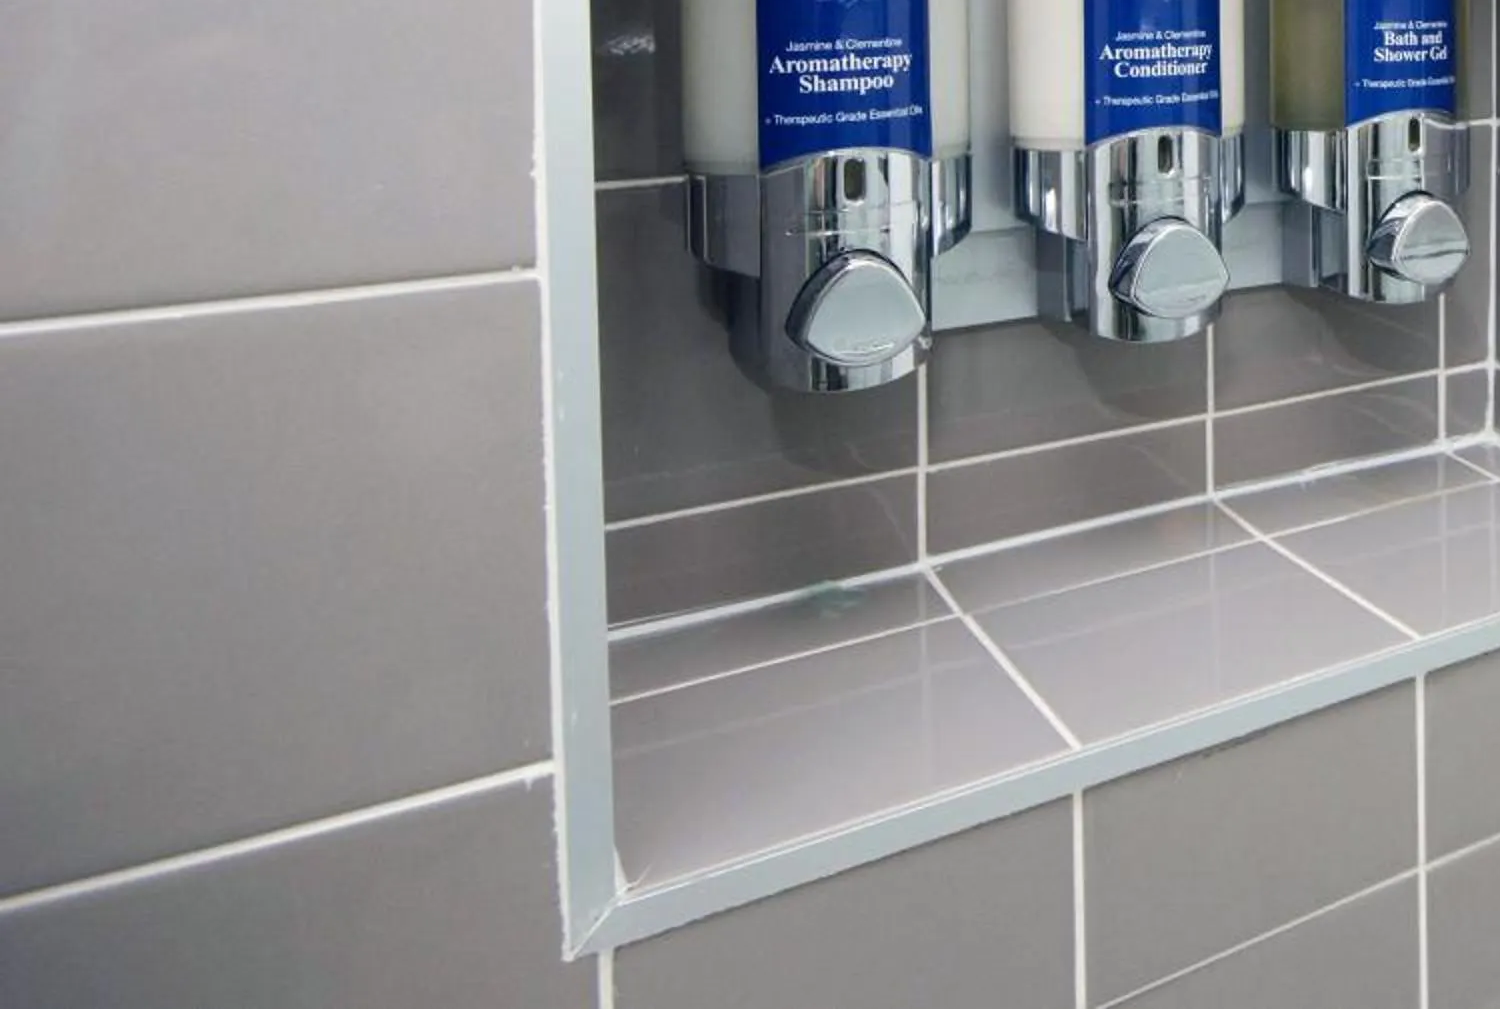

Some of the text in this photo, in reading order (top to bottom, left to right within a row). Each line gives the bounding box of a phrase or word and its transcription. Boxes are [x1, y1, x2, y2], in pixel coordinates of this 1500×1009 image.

[786, 37, 903, 52] Jasmine & Clementine
[1115, 31, 1154, 42] Jasmine
[1384, 30, 1443, 46] Bath and
[1099, 42, 1212, 60] Aromatherapy
[1373, 45, 1447, 62] Shower Gel
[769, 52, 912, 74] Aromatherapy
[1114, 60, 1208, 78] Conditioner
[800, 74, 894, 95] Shampoo
[774, 112, 833, 126] Therapeutic
[836, 111, 867, 123] Grade
[870, 105, 908, 120] Essential
